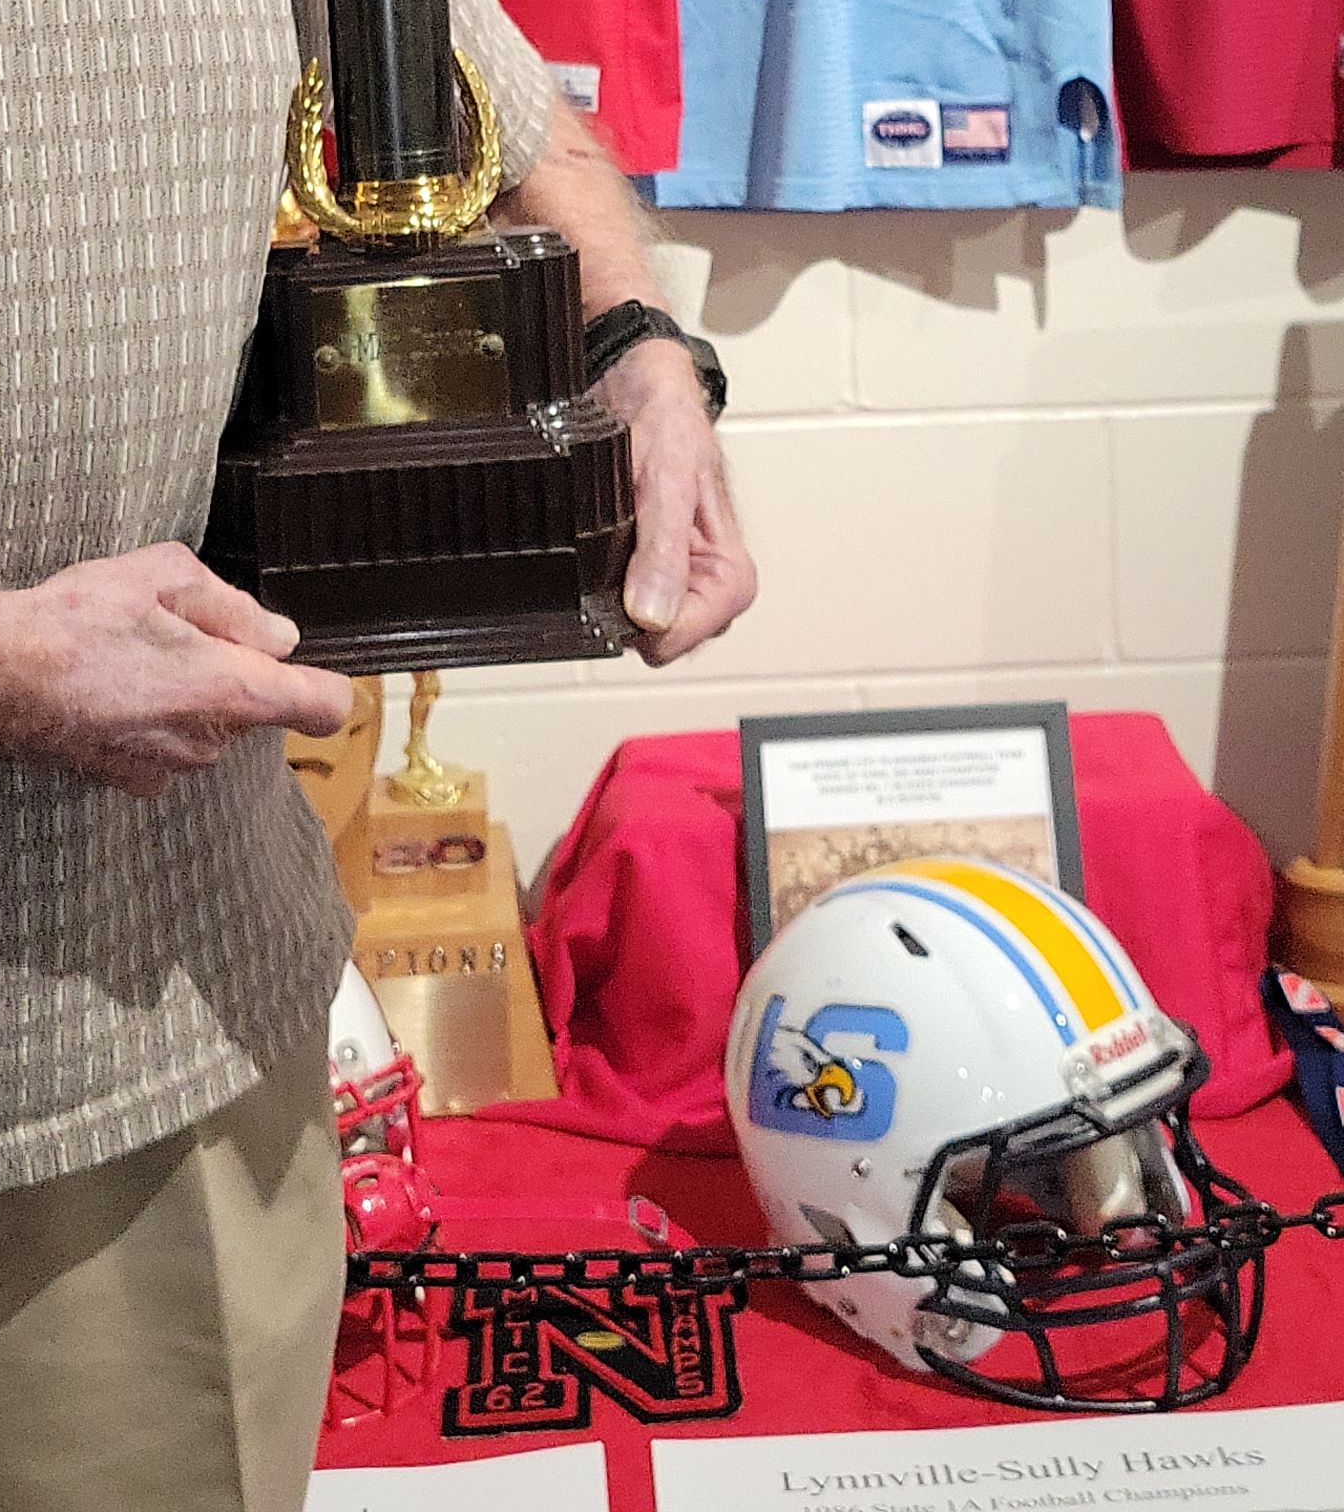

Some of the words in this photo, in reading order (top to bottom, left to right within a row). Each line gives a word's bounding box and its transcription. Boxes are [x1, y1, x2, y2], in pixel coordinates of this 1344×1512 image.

[781, 1455, 1104, 1496] Lynnville-Sully
[1121, 1445, 1267, 1475] Hawks
[991, 1491, 1096, 1512] Football
[1103, 1482, 1251, 1506] Champions
